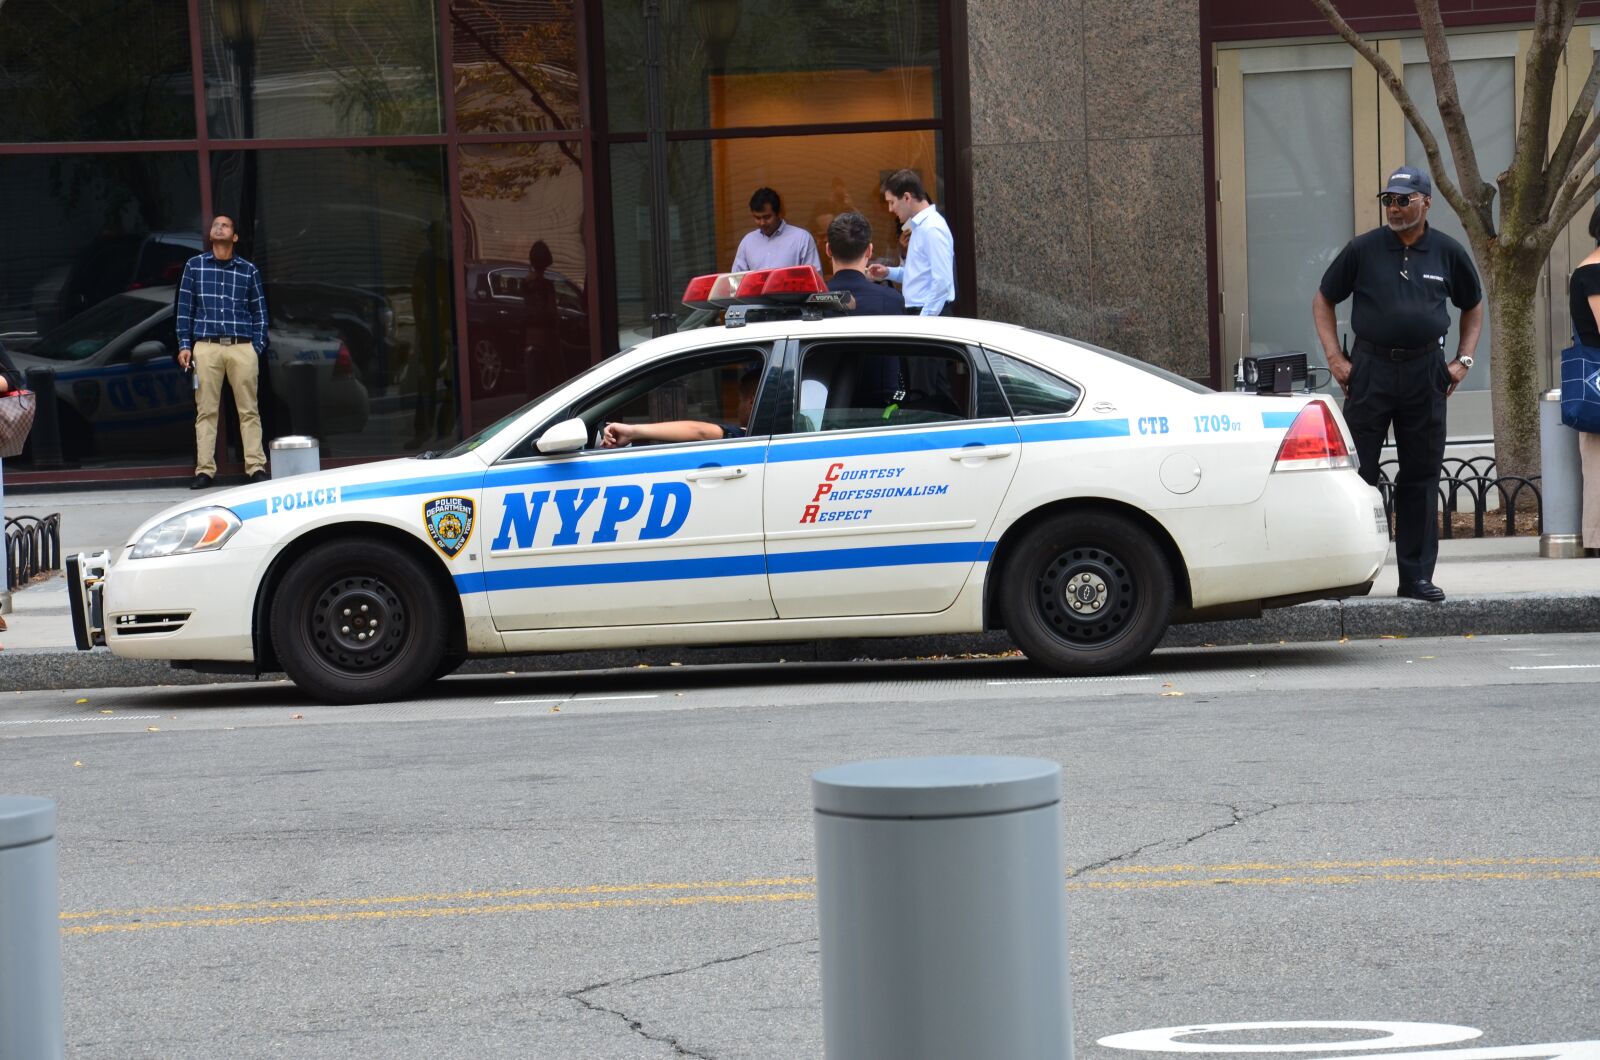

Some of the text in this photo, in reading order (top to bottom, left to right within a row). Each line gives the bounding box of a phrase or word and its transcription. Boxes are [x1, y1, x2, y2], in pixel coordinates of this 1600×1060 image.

[1138, 416, 1169, 435] CTB
[1194, 414, 1231, 433] 1709
[825, 463, 905, 482] COURTESY
[271, 486, 337, 514] POLICE
[435, 498, 462, 507] POLICE
[812, 484, 949, 503] PROFESSIONALISM
[426, 504, 472, 518] DEPARTMENT
[490, 481, 692, 551] NYPD
[799, 504, 872, 524] RESPECT
[428, 523, 446, 549] CITY OF
[455, 518, 473, 550] NEW YORK
